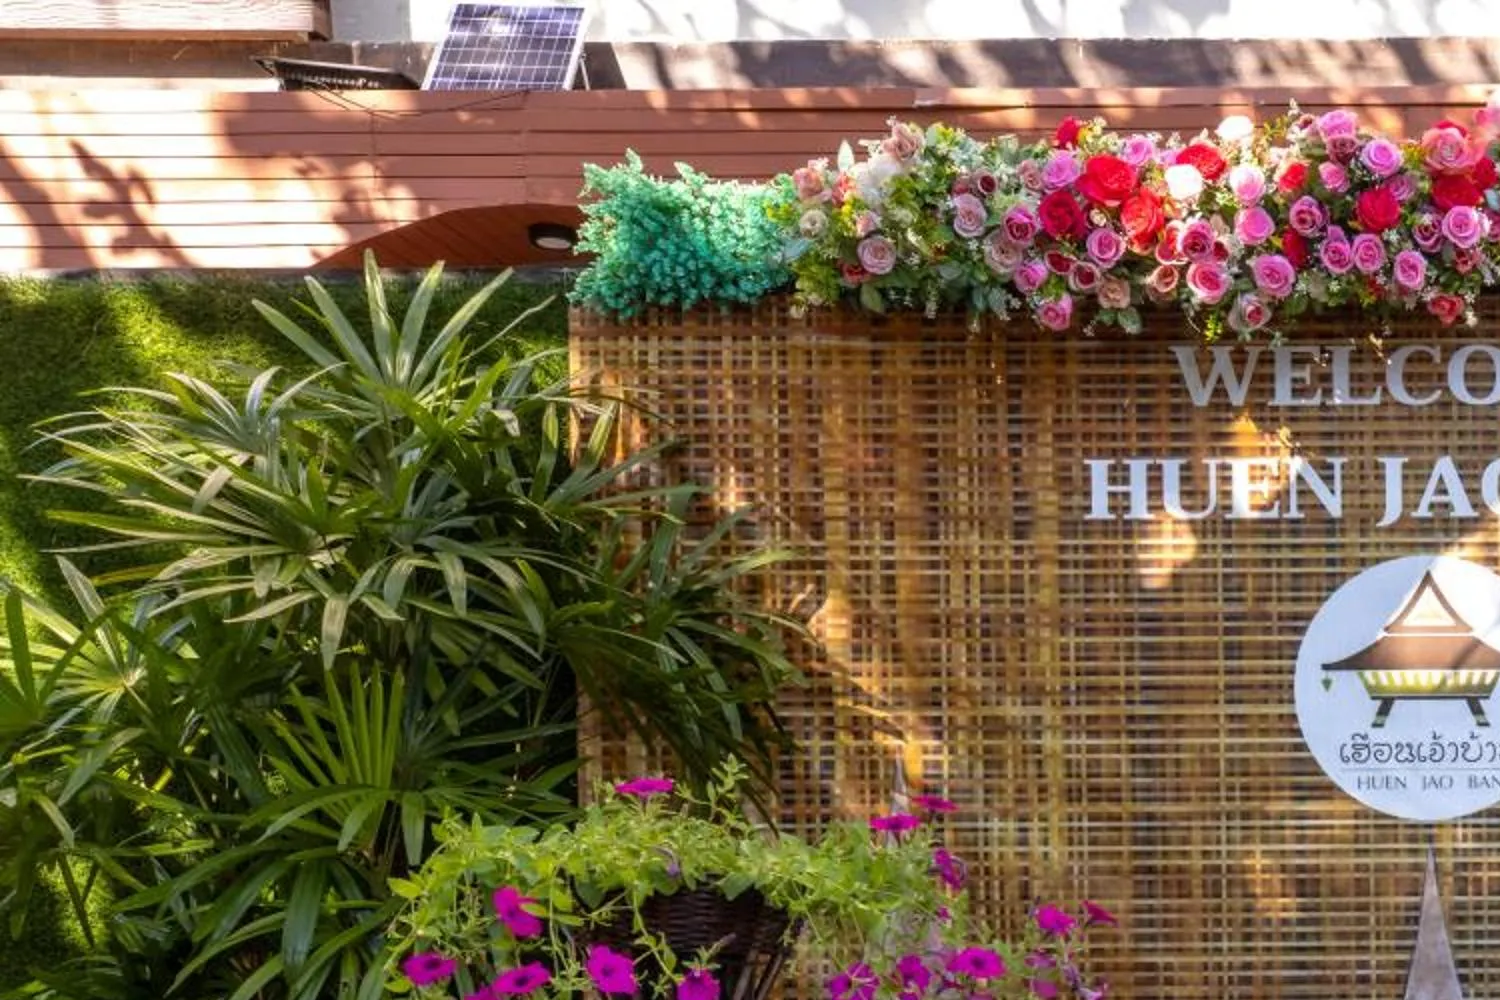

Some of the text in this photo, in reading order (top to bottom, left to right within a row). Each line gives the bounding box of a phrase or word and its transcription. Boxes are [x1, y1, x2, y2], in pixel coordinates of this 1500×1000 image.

[1082, 457, 1349, 521] HUEN
[1357, 775, 1407, 790] HUEN
[1421, 775, 1454, 790] JAO
